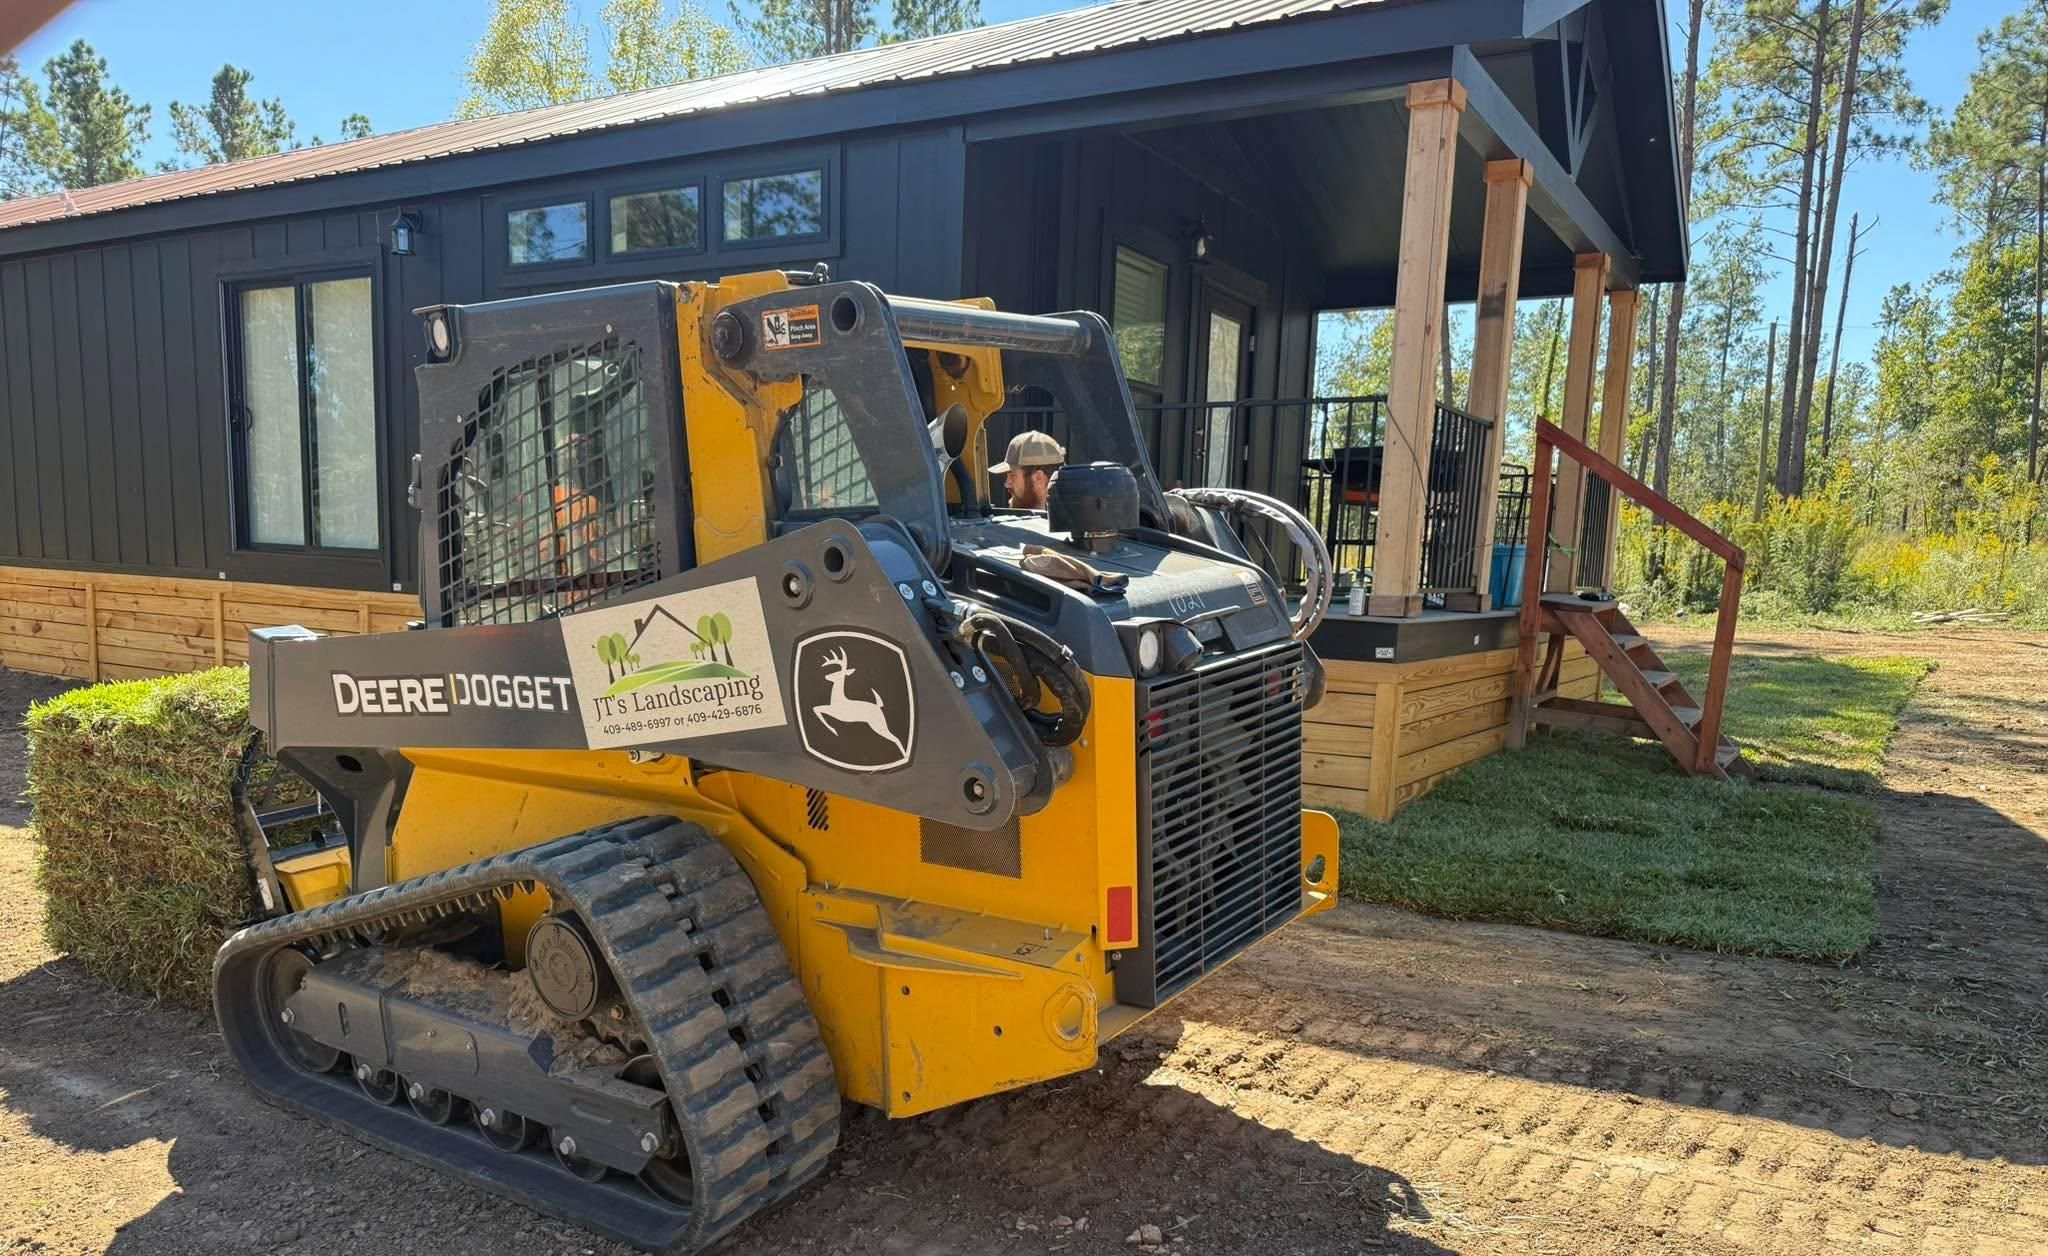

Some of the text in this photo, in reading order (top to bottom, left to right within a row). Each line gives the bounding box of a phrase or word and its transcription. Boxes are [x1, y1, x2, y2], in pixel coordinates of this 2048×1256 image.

[1168, 589, 1206, 617] 1021
[331, 673, 449, 714] DEERE
[593, 674, 764, 722] JT's Landscaping
[603, 703, 762, 736] 409-489-6997 or 409-429-6876
